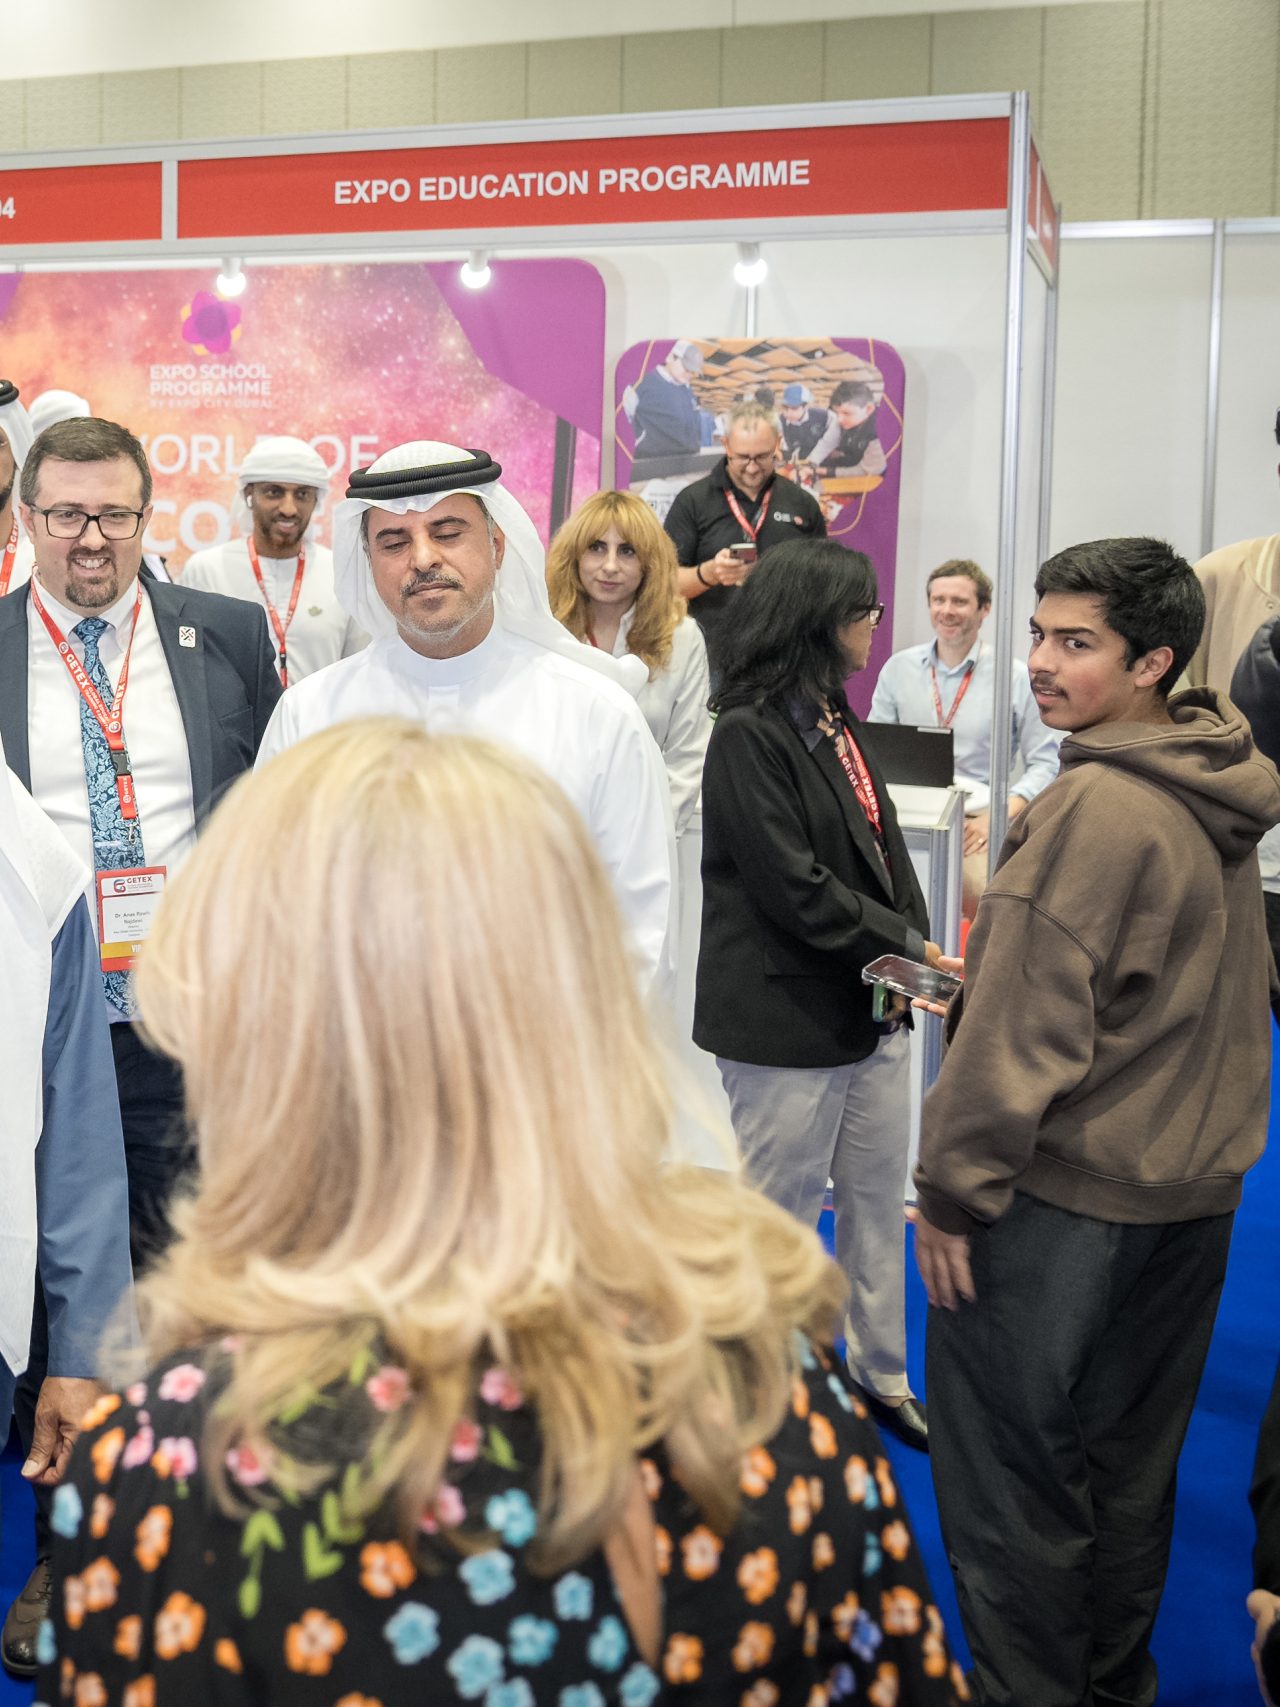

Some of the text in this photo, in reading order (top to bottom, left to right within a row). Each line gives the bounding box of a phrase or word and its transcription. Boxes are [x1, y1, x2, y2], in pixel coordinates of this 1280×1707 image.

[334, 159, 810, 205] EXPO EDUCATION PROGRAMME
[149, 363, 272, 380] EXPO SCHOOL
[149, 381, 272, 396] PROGRAMME
[140, 433, 268, 476] ORL
[66, 653, 90, 689] GETEX
[111, 683, 126, 719] GETEX
[842, 758, 859, 788] GETEX
[861, 777, 877, 811] GETEX
[126, 875, 153, 884] GETEX
